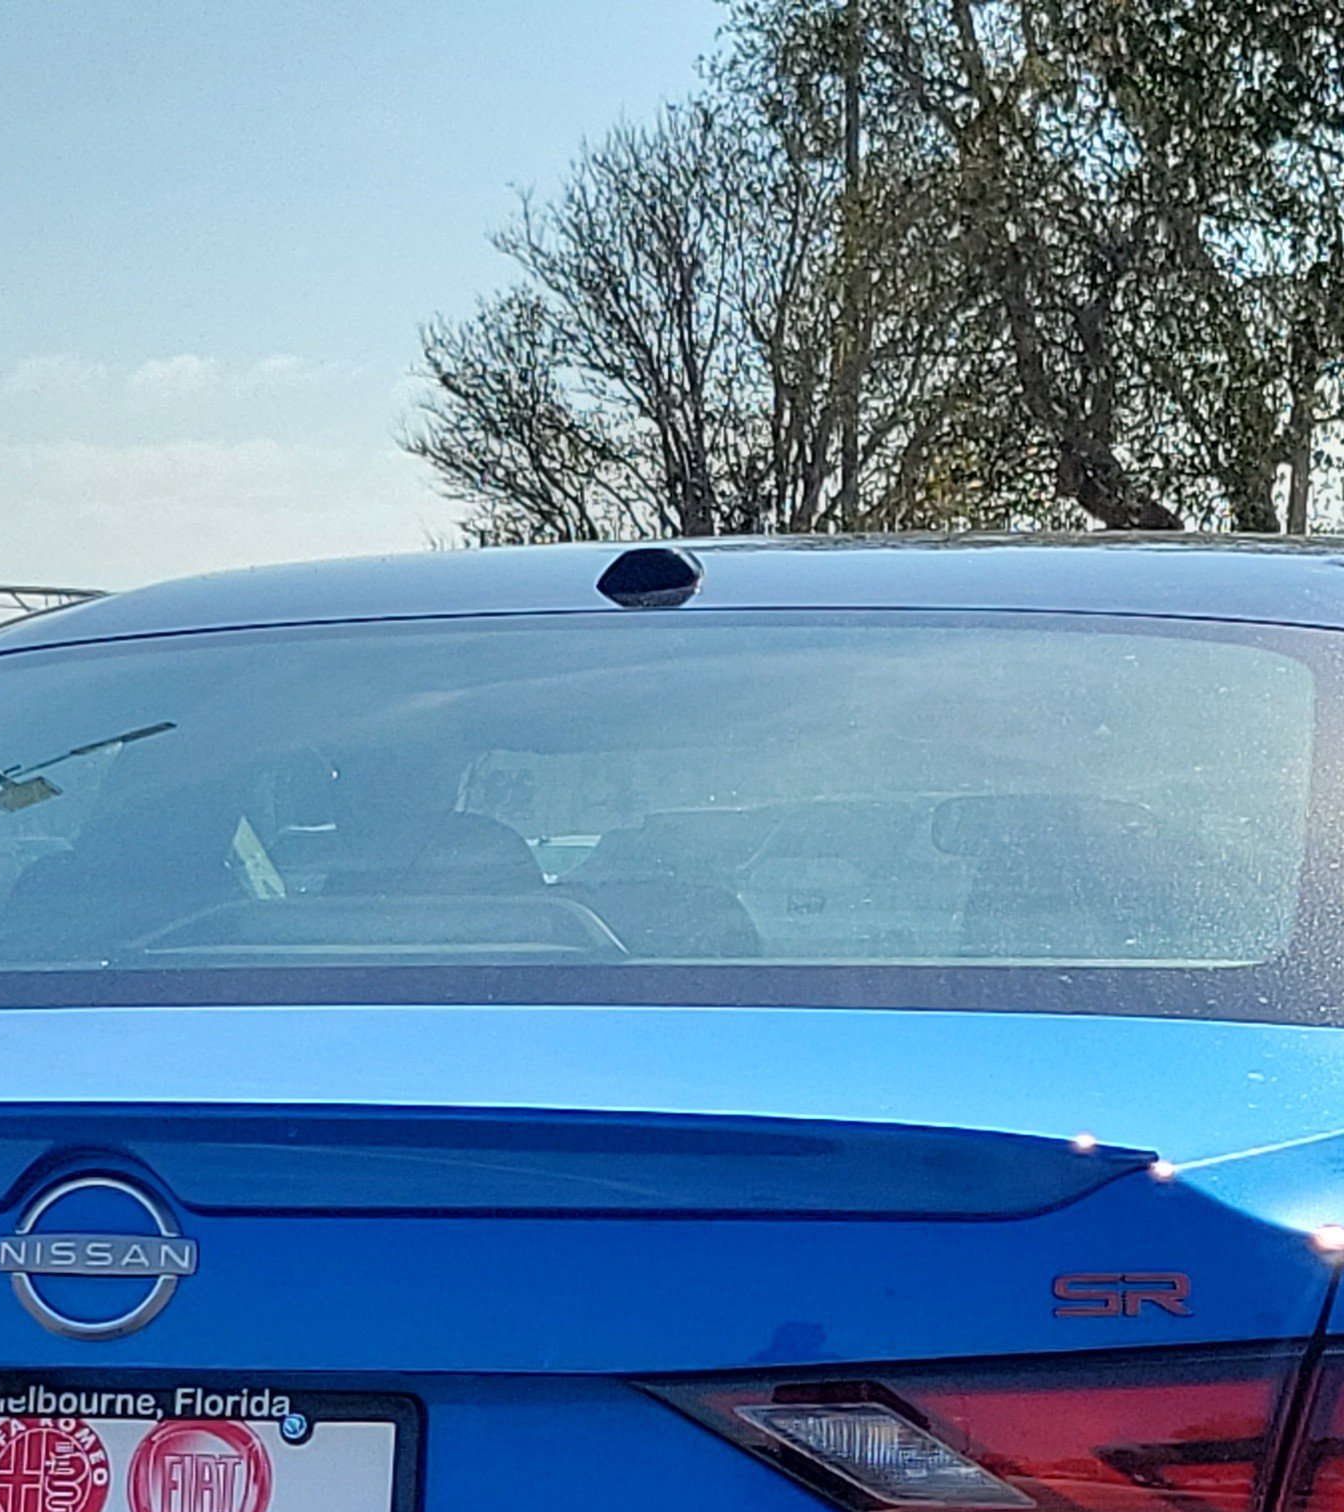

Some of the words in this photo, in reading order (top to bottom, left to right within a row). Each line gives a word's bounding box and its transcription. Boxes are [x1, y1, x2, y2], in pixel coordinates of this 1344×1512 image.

[0, 1241, 191, 1269] NISSAN
[1053, 1272, 1193, 1317] SR
[174, 1387, 292, 1418] Florida
